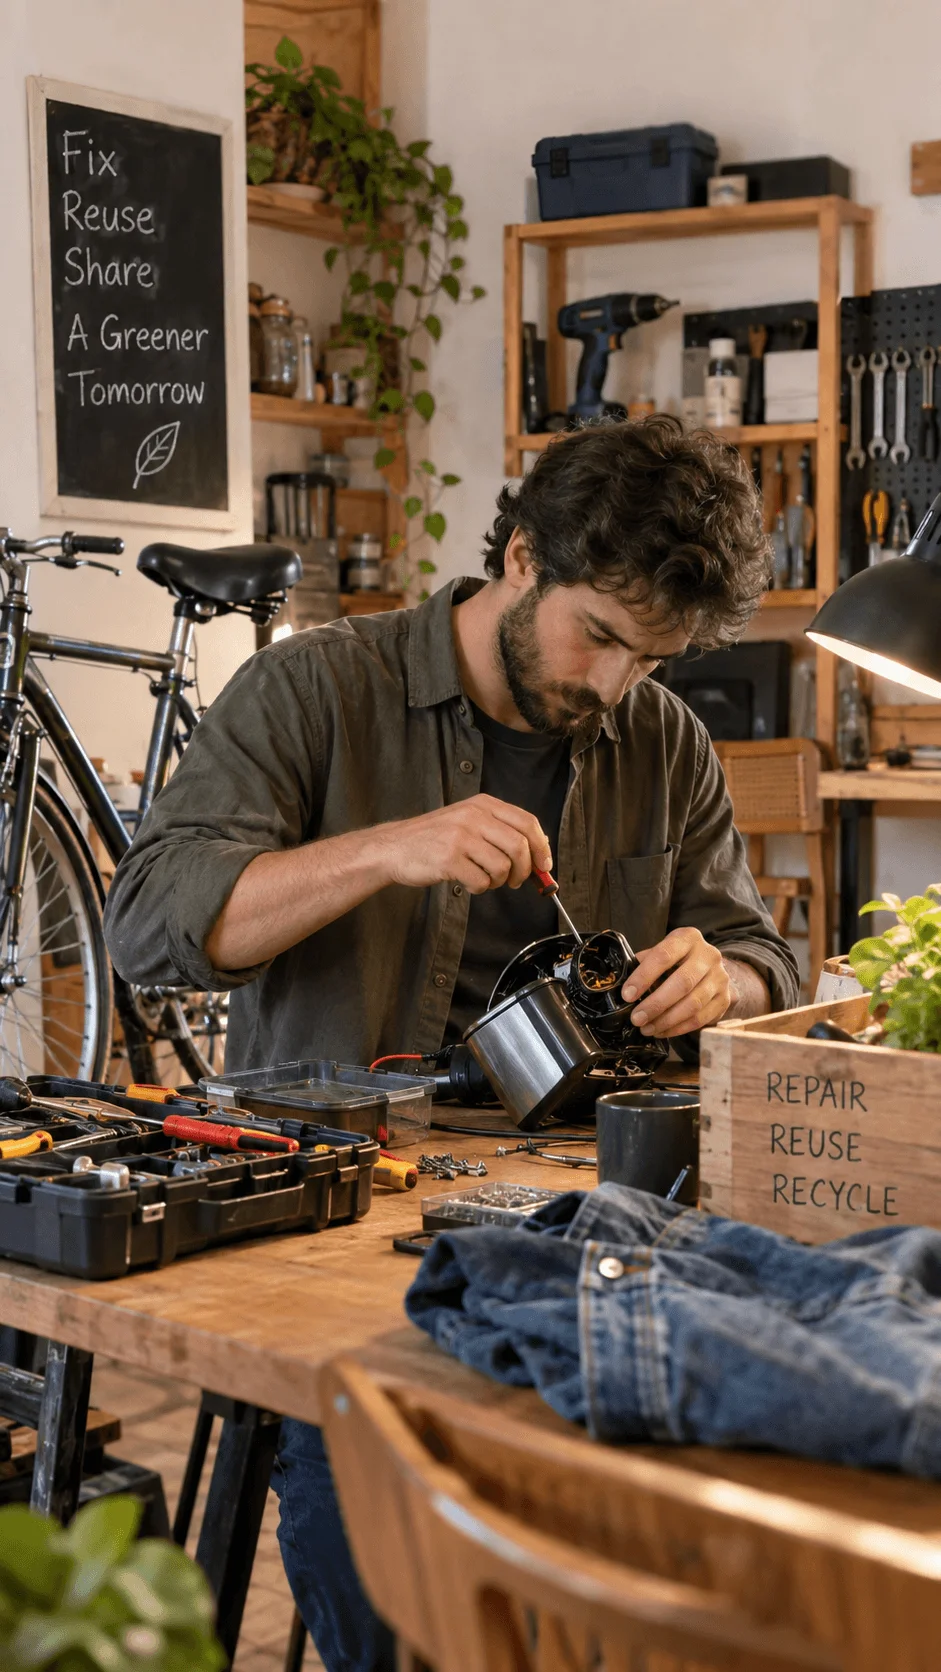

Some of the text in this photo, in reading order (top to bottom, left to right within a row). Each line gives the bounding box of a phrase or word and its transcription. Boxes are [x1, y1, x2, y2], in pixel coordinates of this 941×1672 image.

[62, 129, 118, 177] Fix
[62, 189, 155, 235] Reuse
[64, 246, 155, 288] Share
[67, 313, 209, 352] A Greener
[67, 369, 206, 406] Tomorrow
[767, 1071, 868, 1112] REPAIR
[770, 1123, 862, 1162] REUSE
[773, 1173, 899, 1216] RECYCLE
